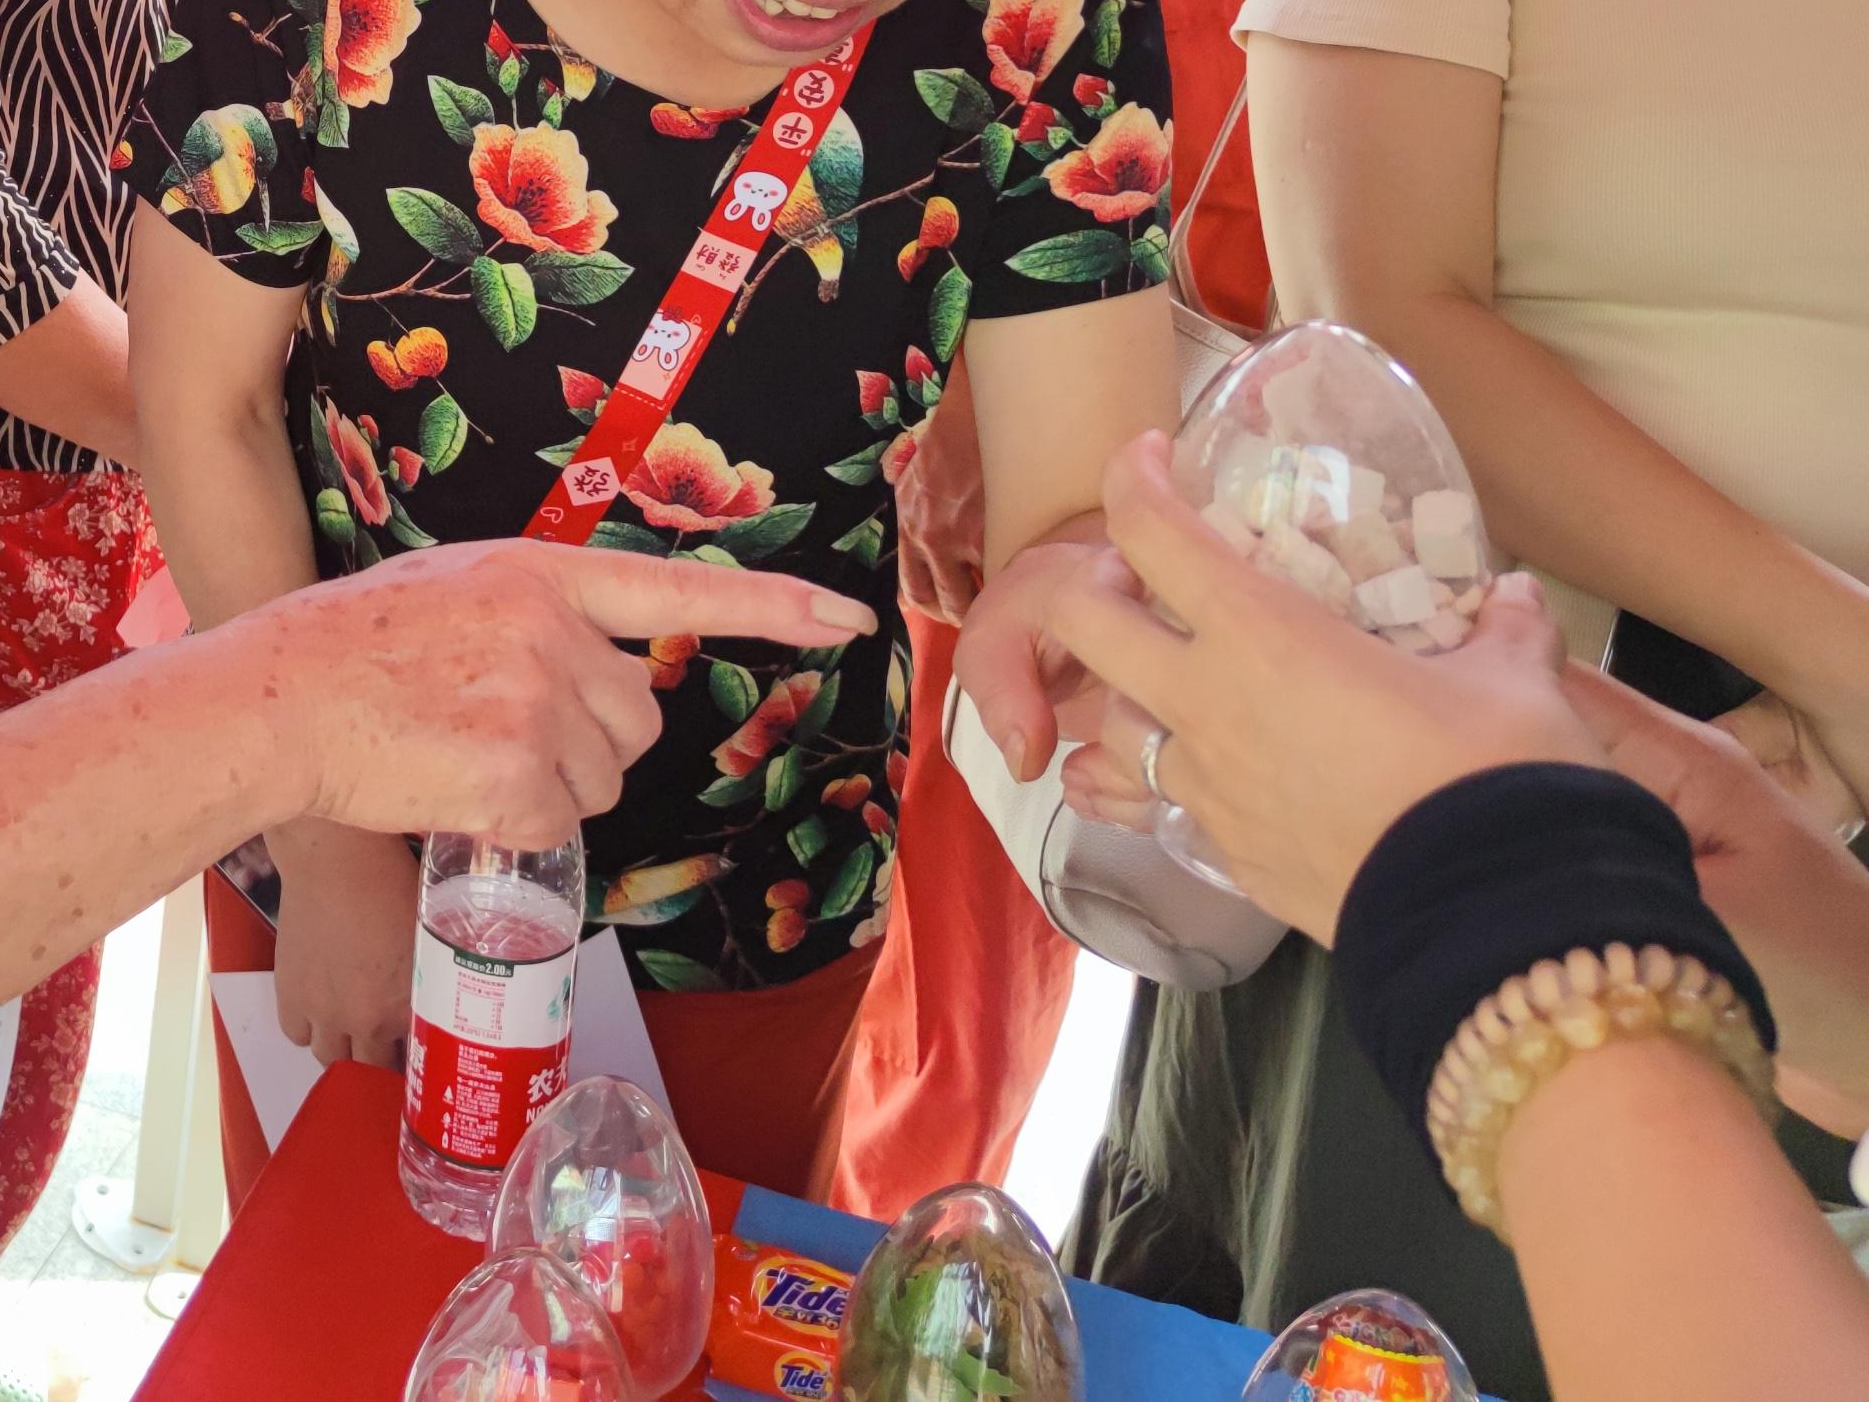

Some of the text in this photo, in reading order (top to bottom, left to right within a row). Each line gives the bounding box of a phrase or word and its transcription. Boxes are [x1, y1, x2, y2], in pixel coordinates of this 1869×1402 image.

[572, 464, 614, 499] 發
[761, 1267, 848, 1317] Tide
[780, 1363, 825, 1389] Tide
